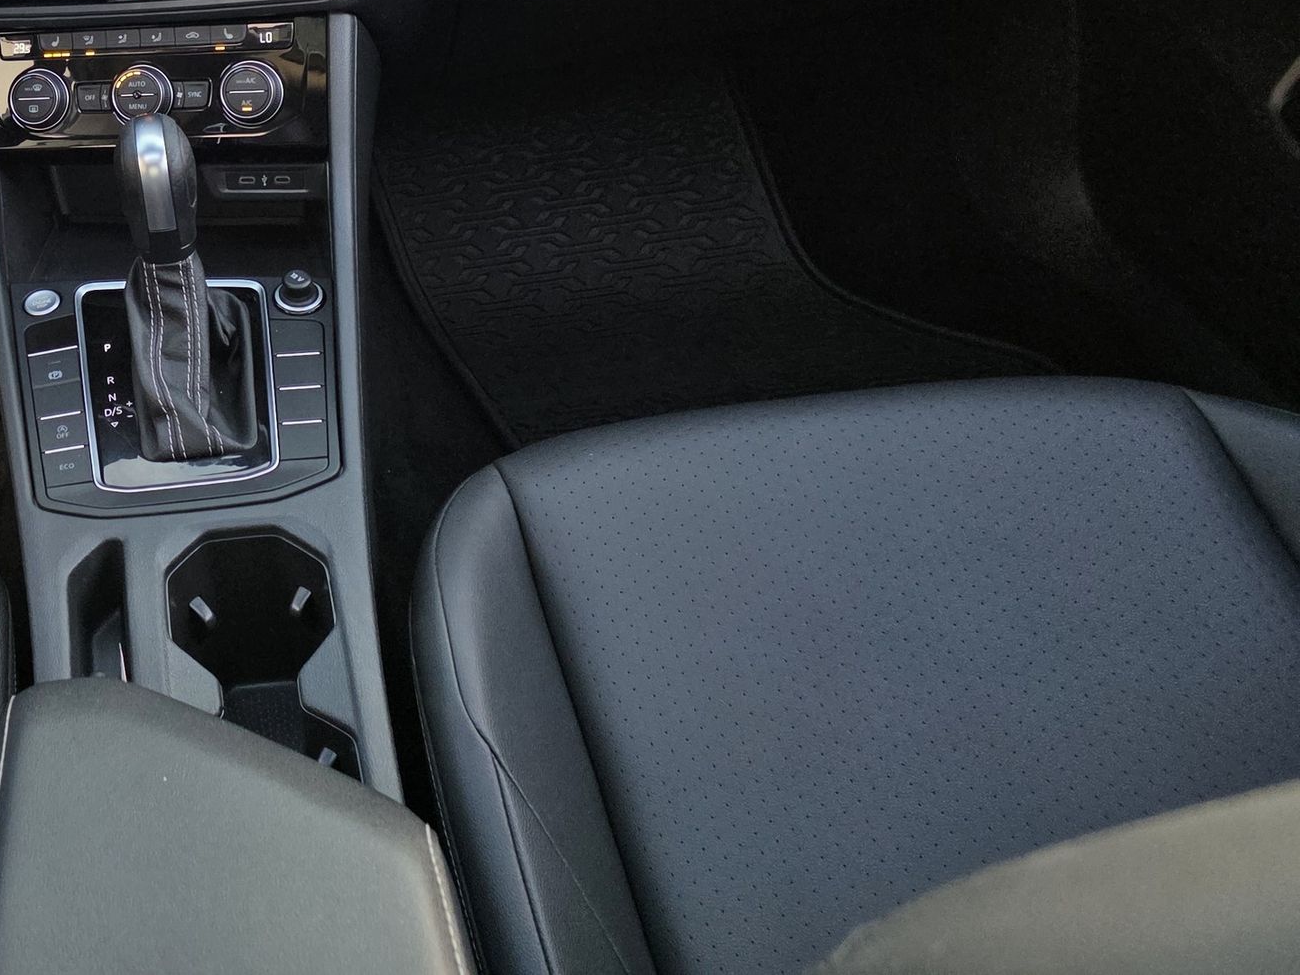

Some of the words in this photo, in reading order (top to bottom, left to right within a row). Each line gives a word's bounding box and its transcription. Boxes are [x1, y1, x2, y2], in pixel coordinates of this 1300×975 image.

[259, 32, 273, 44] LO
[128, 80, 146, 88] AUTO
[84, 94, 96, 102] OFF
[103, 344, 111, 353] P
[107, 376, 115, 385] R
[108, 393, 117, 402] N
[104, 406, 123, 417] D/S
[56, 431, 69, 439] OFF
[59, 462, 75, 470] ECO
